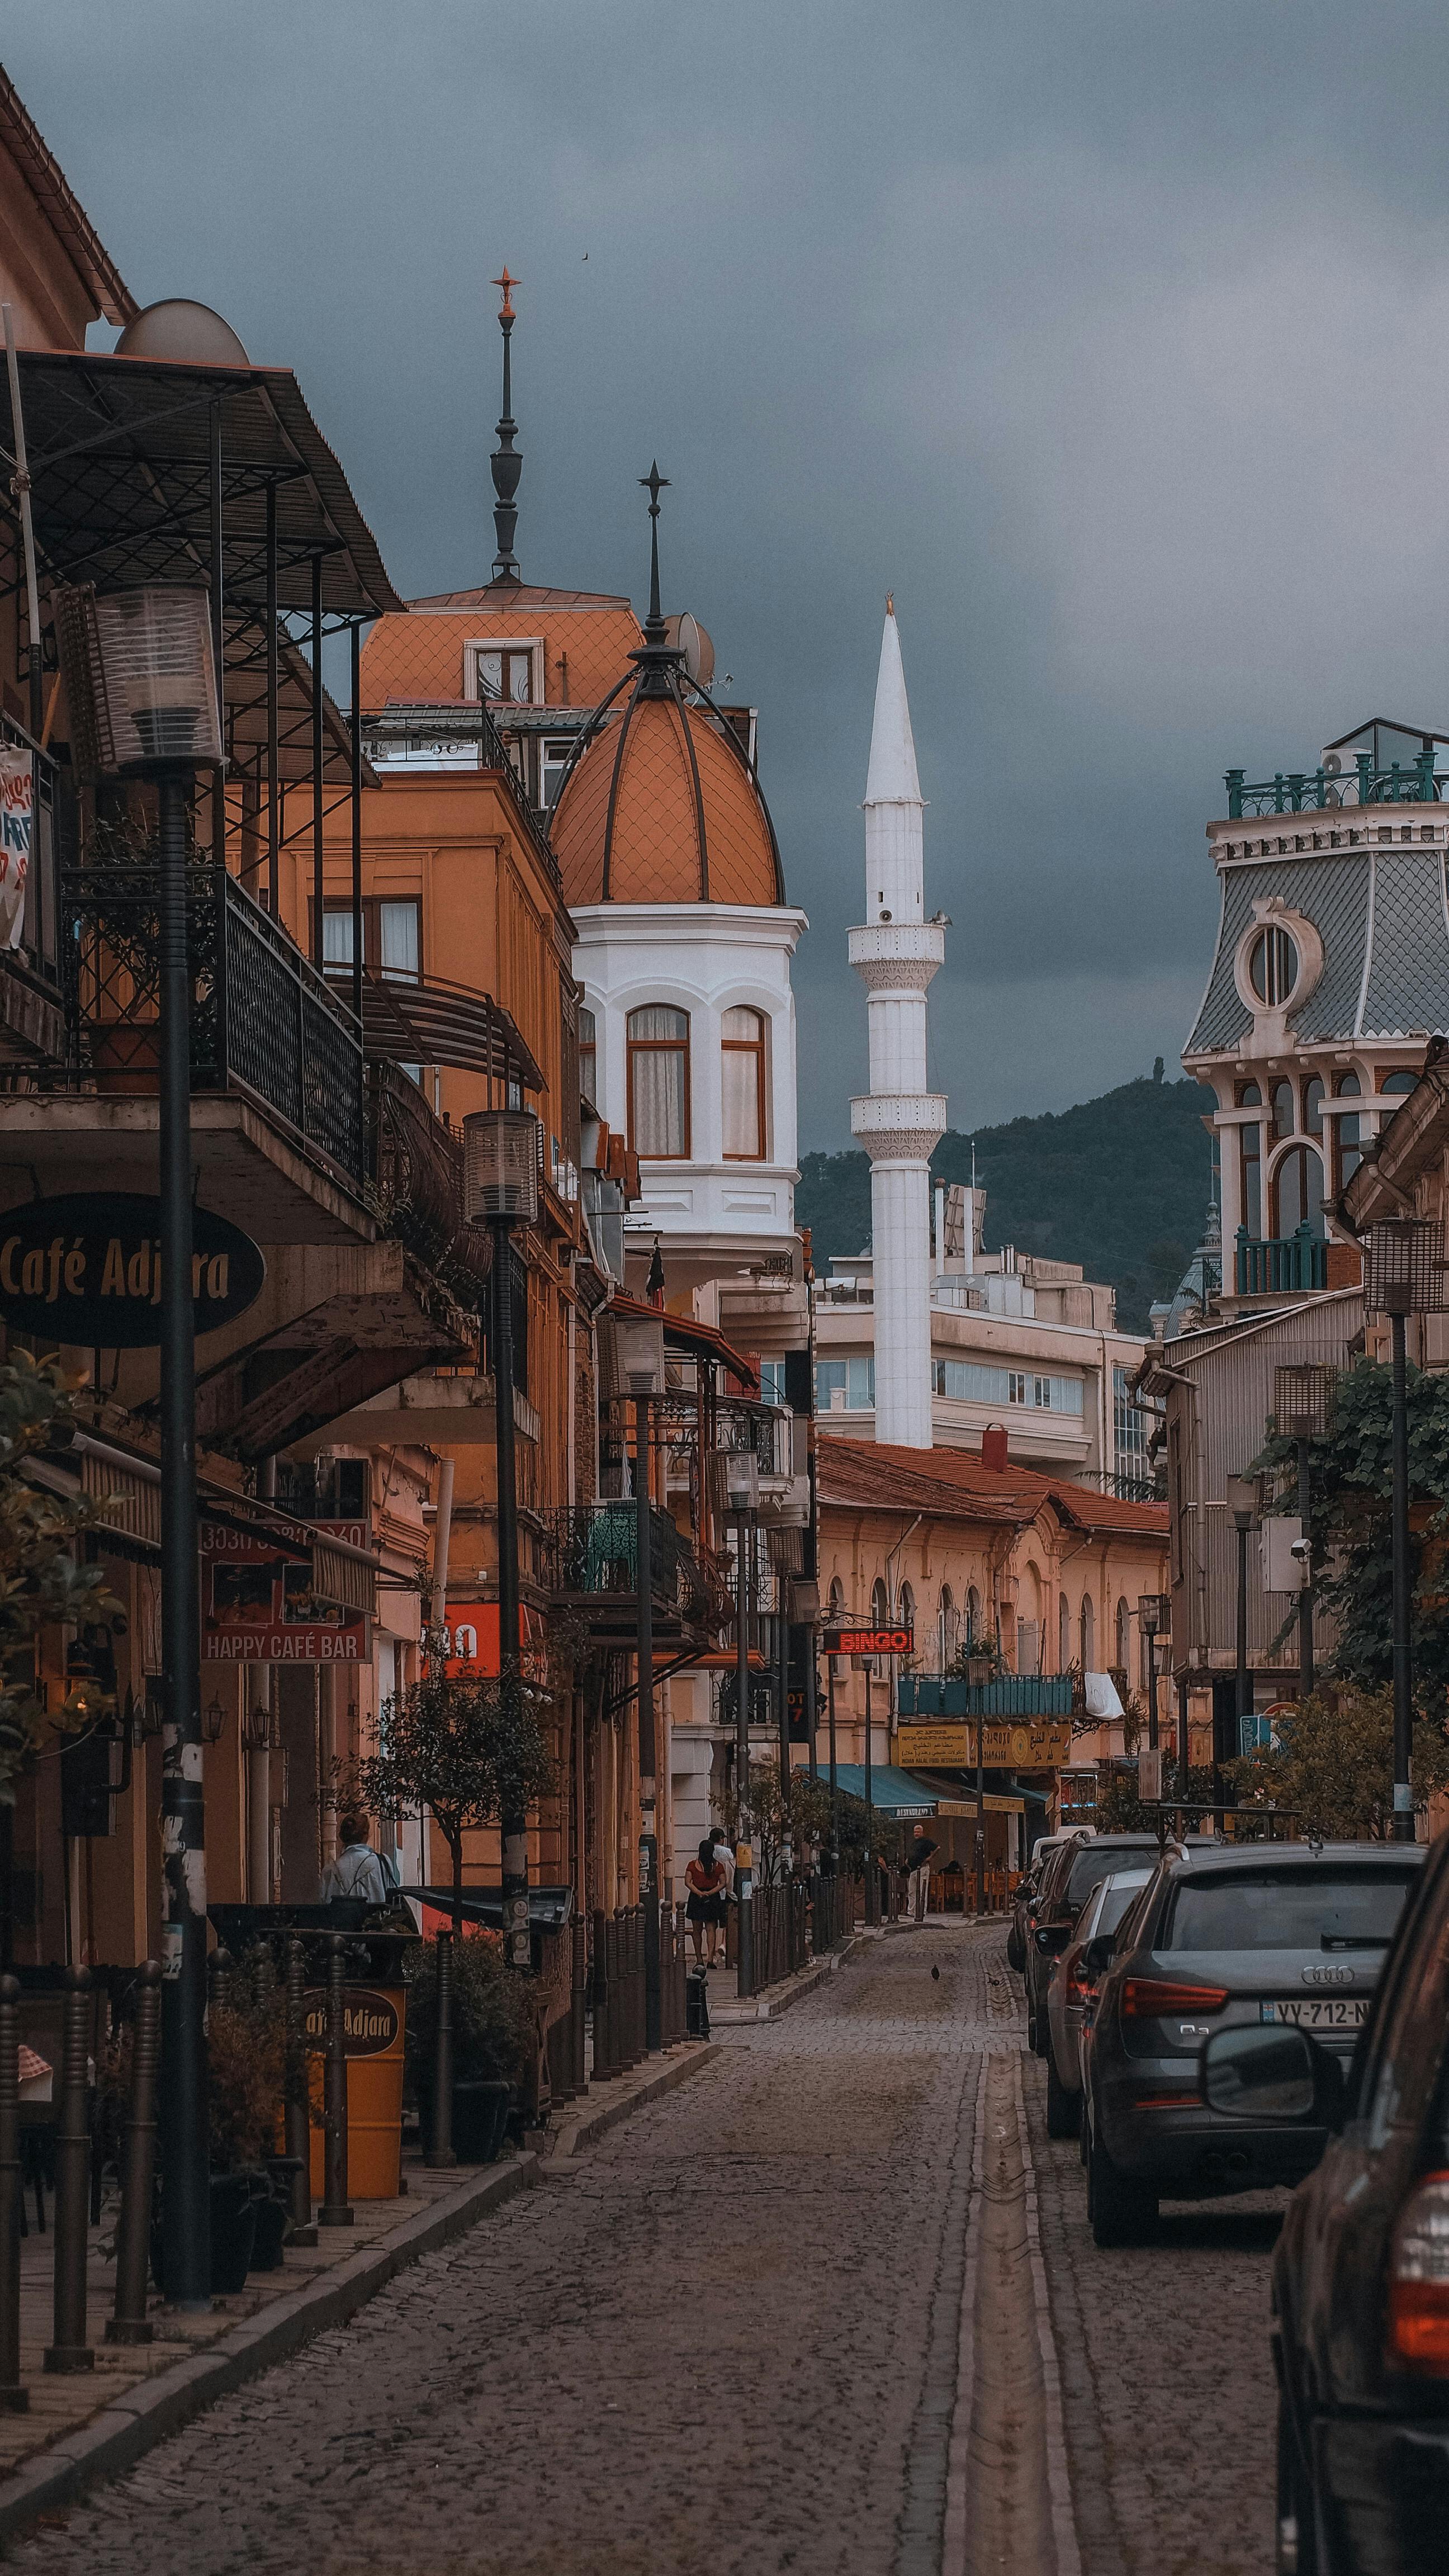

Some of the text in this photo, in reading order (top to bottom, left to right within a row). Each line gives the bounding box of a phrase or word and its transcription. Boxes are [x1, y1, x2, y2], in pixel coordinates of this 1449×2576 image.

[0, 1236, 229, 1305] Café Adjra
[207, 1632, 357, 1658] HAPPY CAFÉ BAR
[840, 1632, 907, 1650] BINGO
[344, 2008, 390, 2039] Adjara
